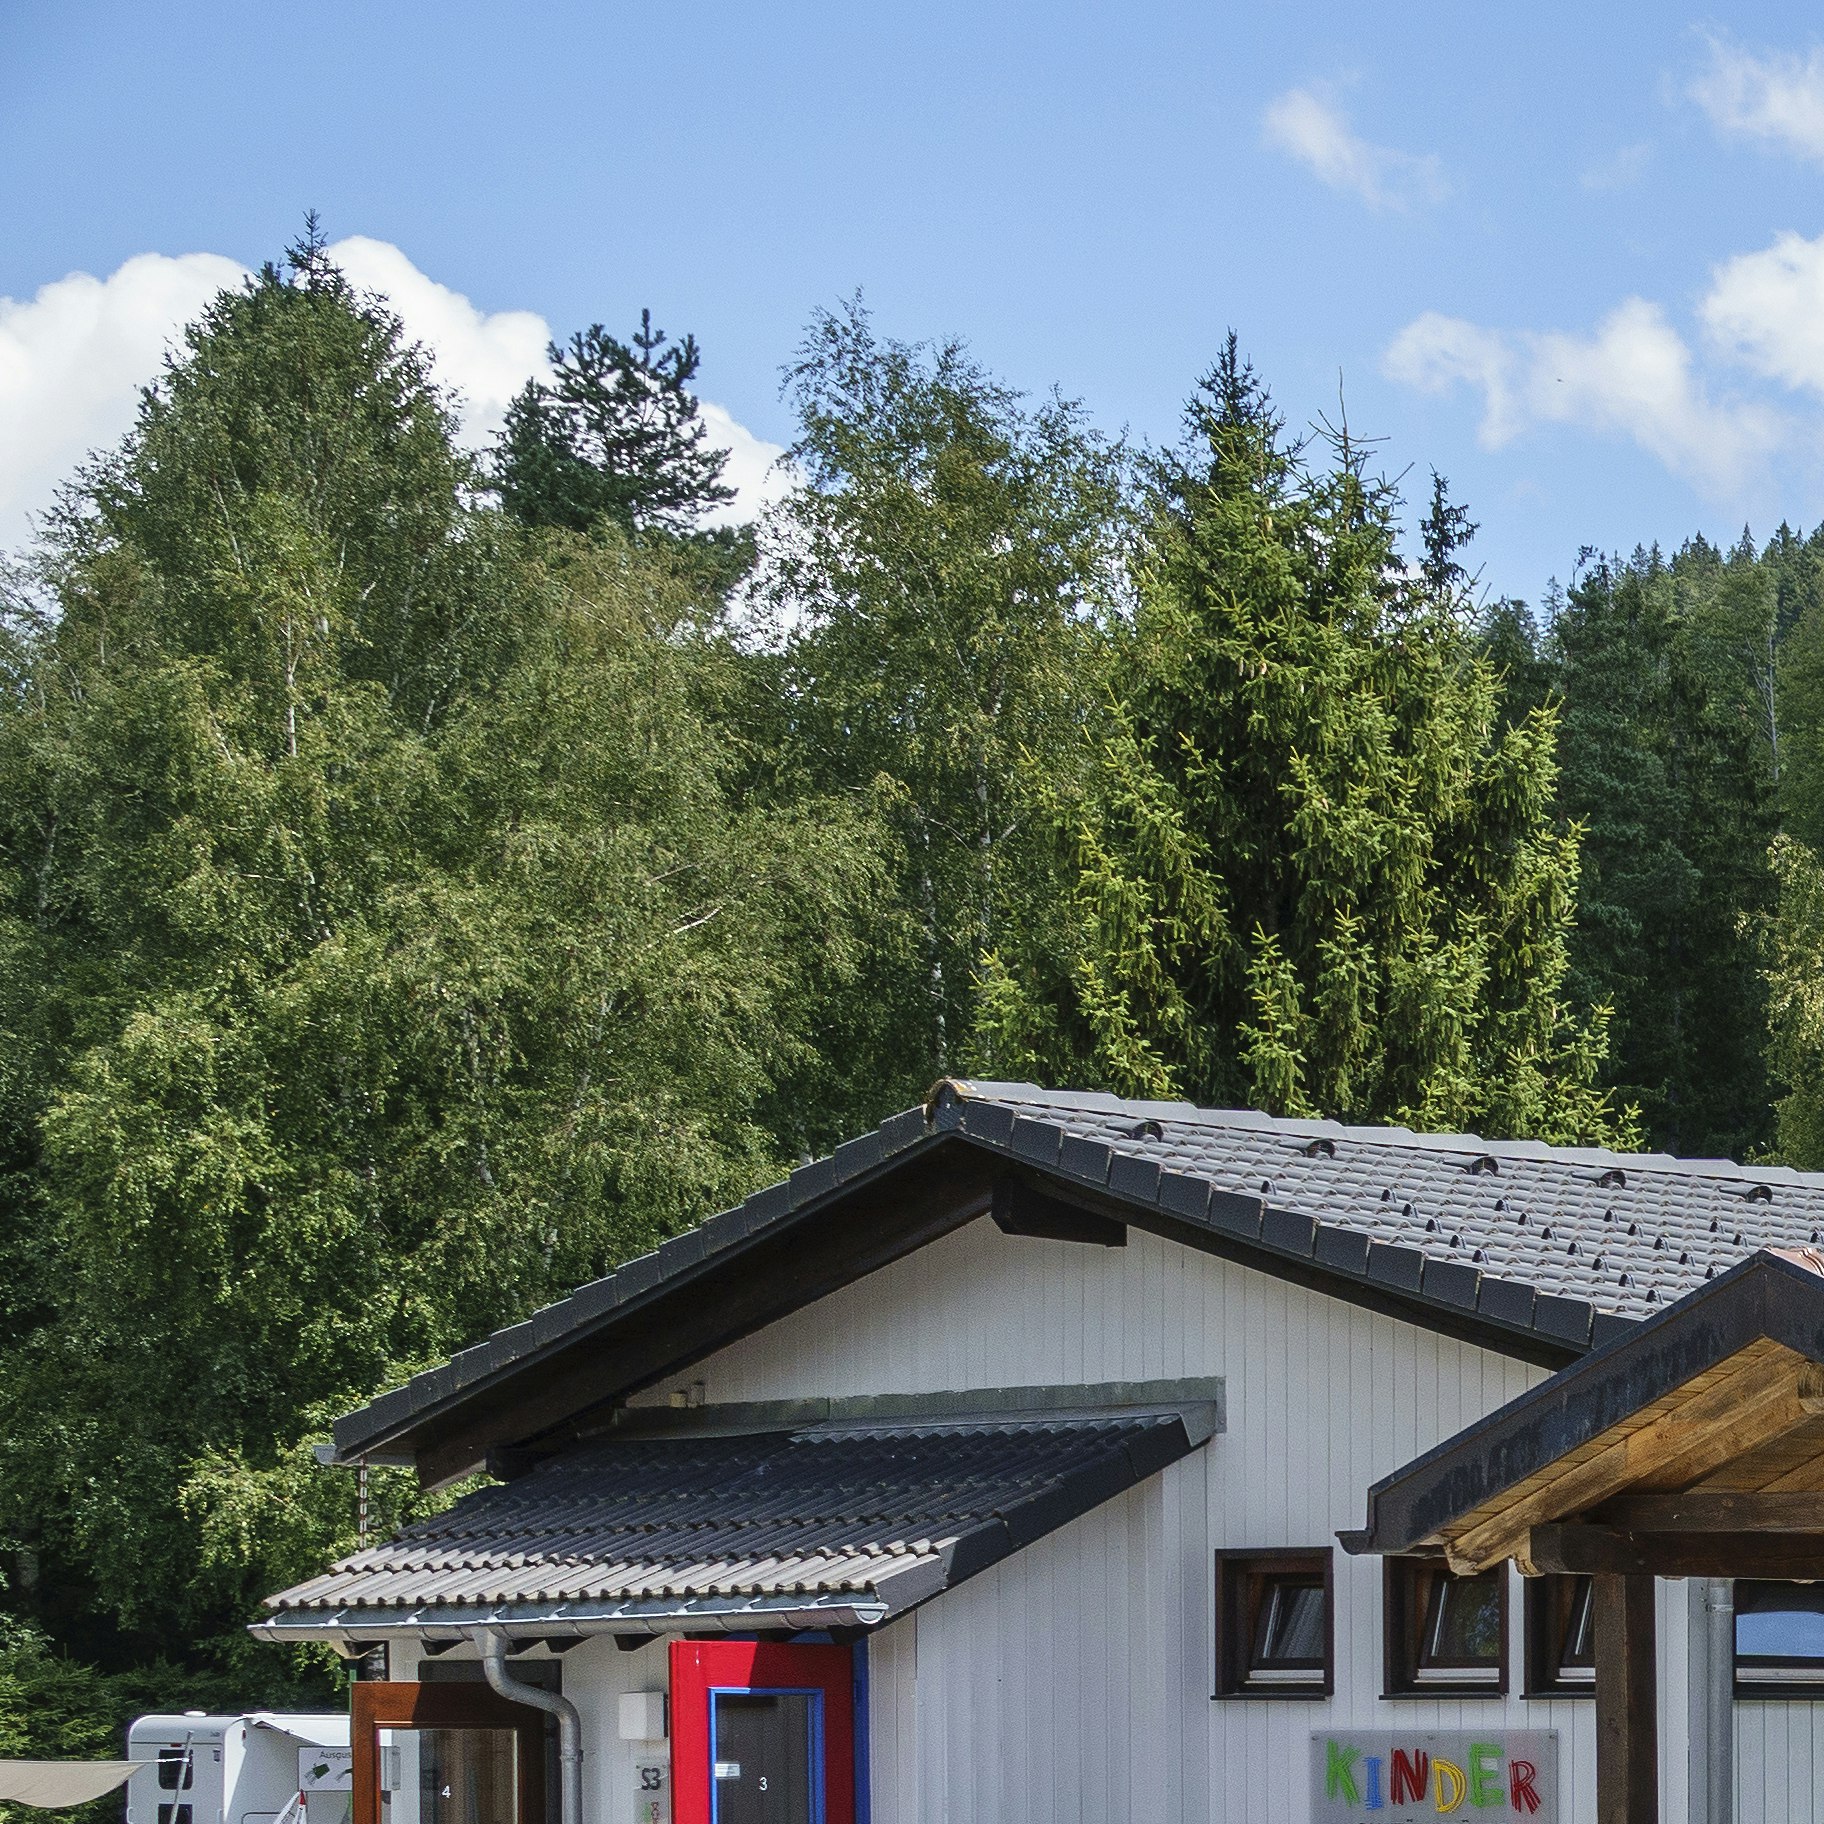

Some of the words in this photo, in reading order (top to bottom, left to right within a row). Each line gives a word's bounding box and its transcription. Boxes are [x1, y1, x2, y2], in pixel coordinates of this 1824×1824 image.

[758, 1776, 768, 1791] 3
[1325, 1738, 1542, 1814] KINDER
[441, 1785, 451, 1799] 4
